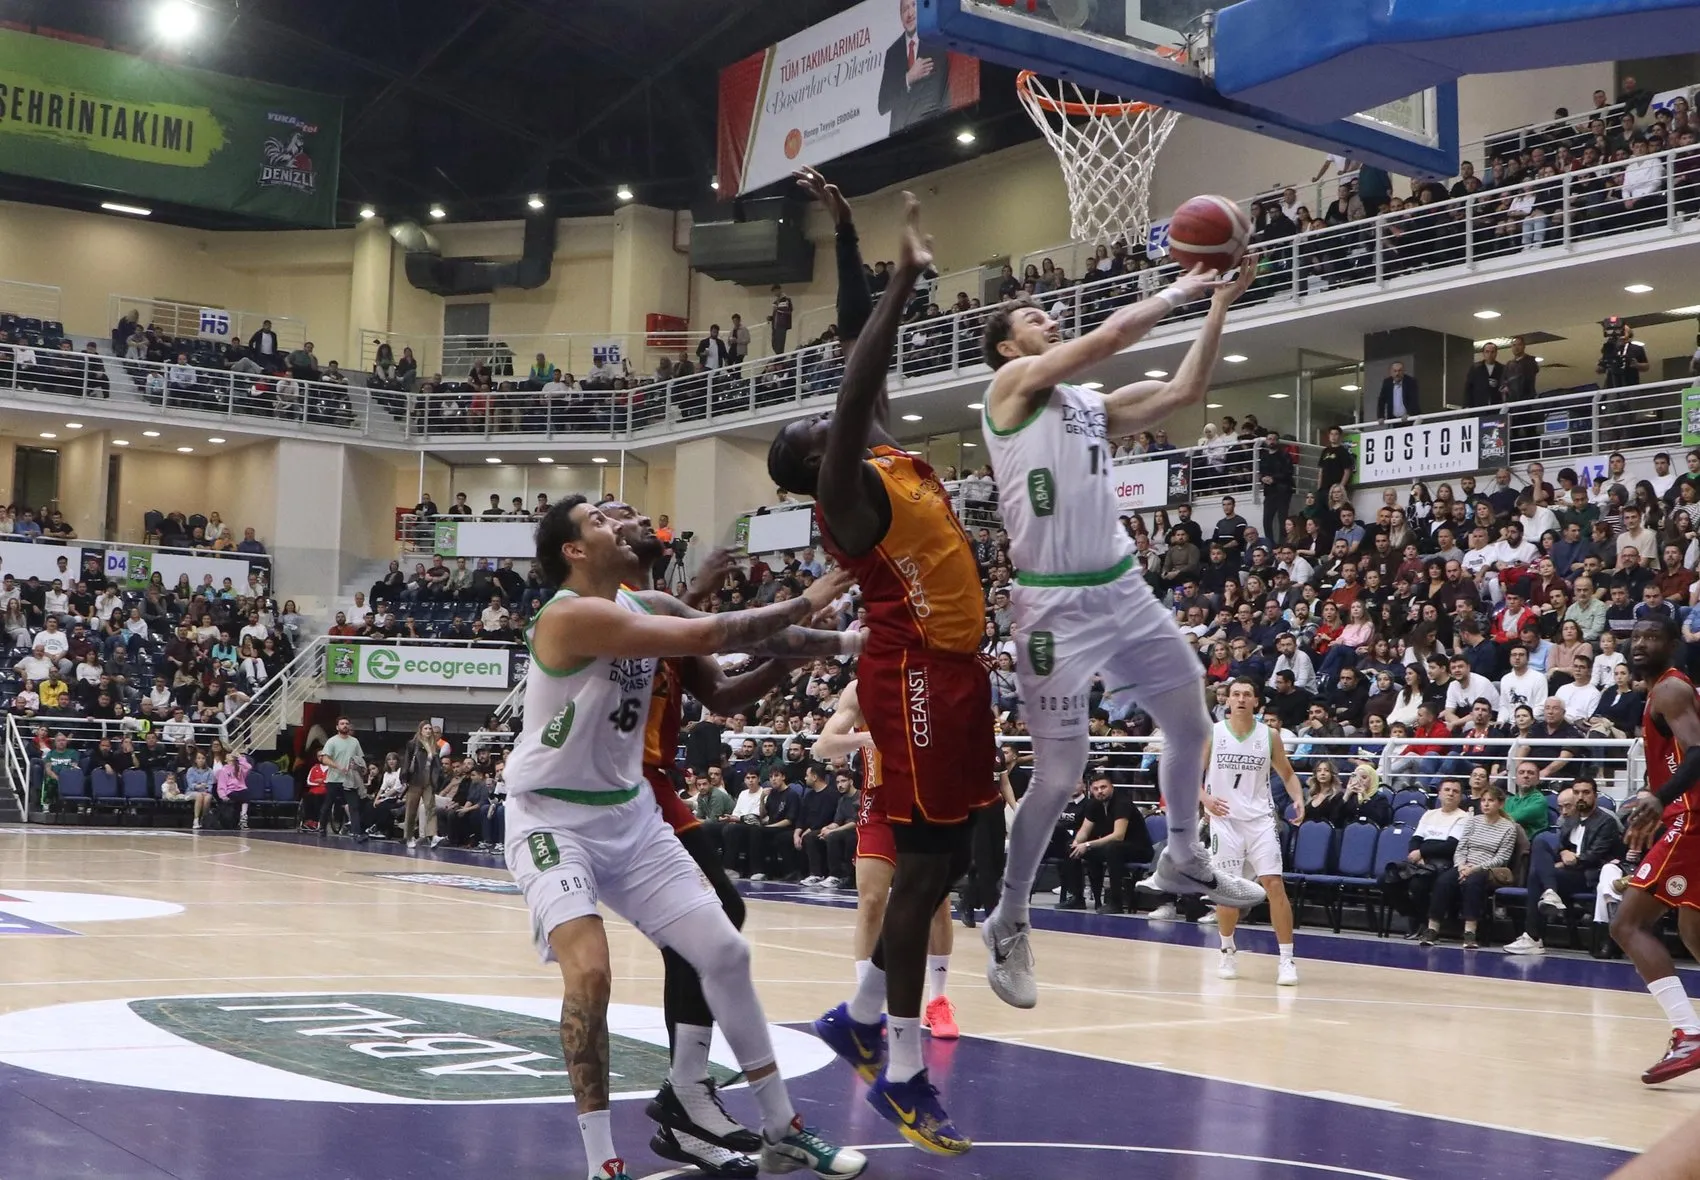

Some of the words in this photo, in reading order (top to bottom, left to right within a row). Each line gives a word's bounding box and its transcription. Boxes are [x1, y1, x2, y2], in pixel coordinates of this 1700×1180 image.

[801, 27, 870, 74] TAKIMLARIMIZA
[201, 313, 229, 335] H5
[1366, 425, 1472, 465] BOSTON
[1115, 482, 1144, 498] dem
[107, 556, 126, 571] D4
[404, 660, 502, 679] ecogreen
[1233, 773, 1242, 789] 1
